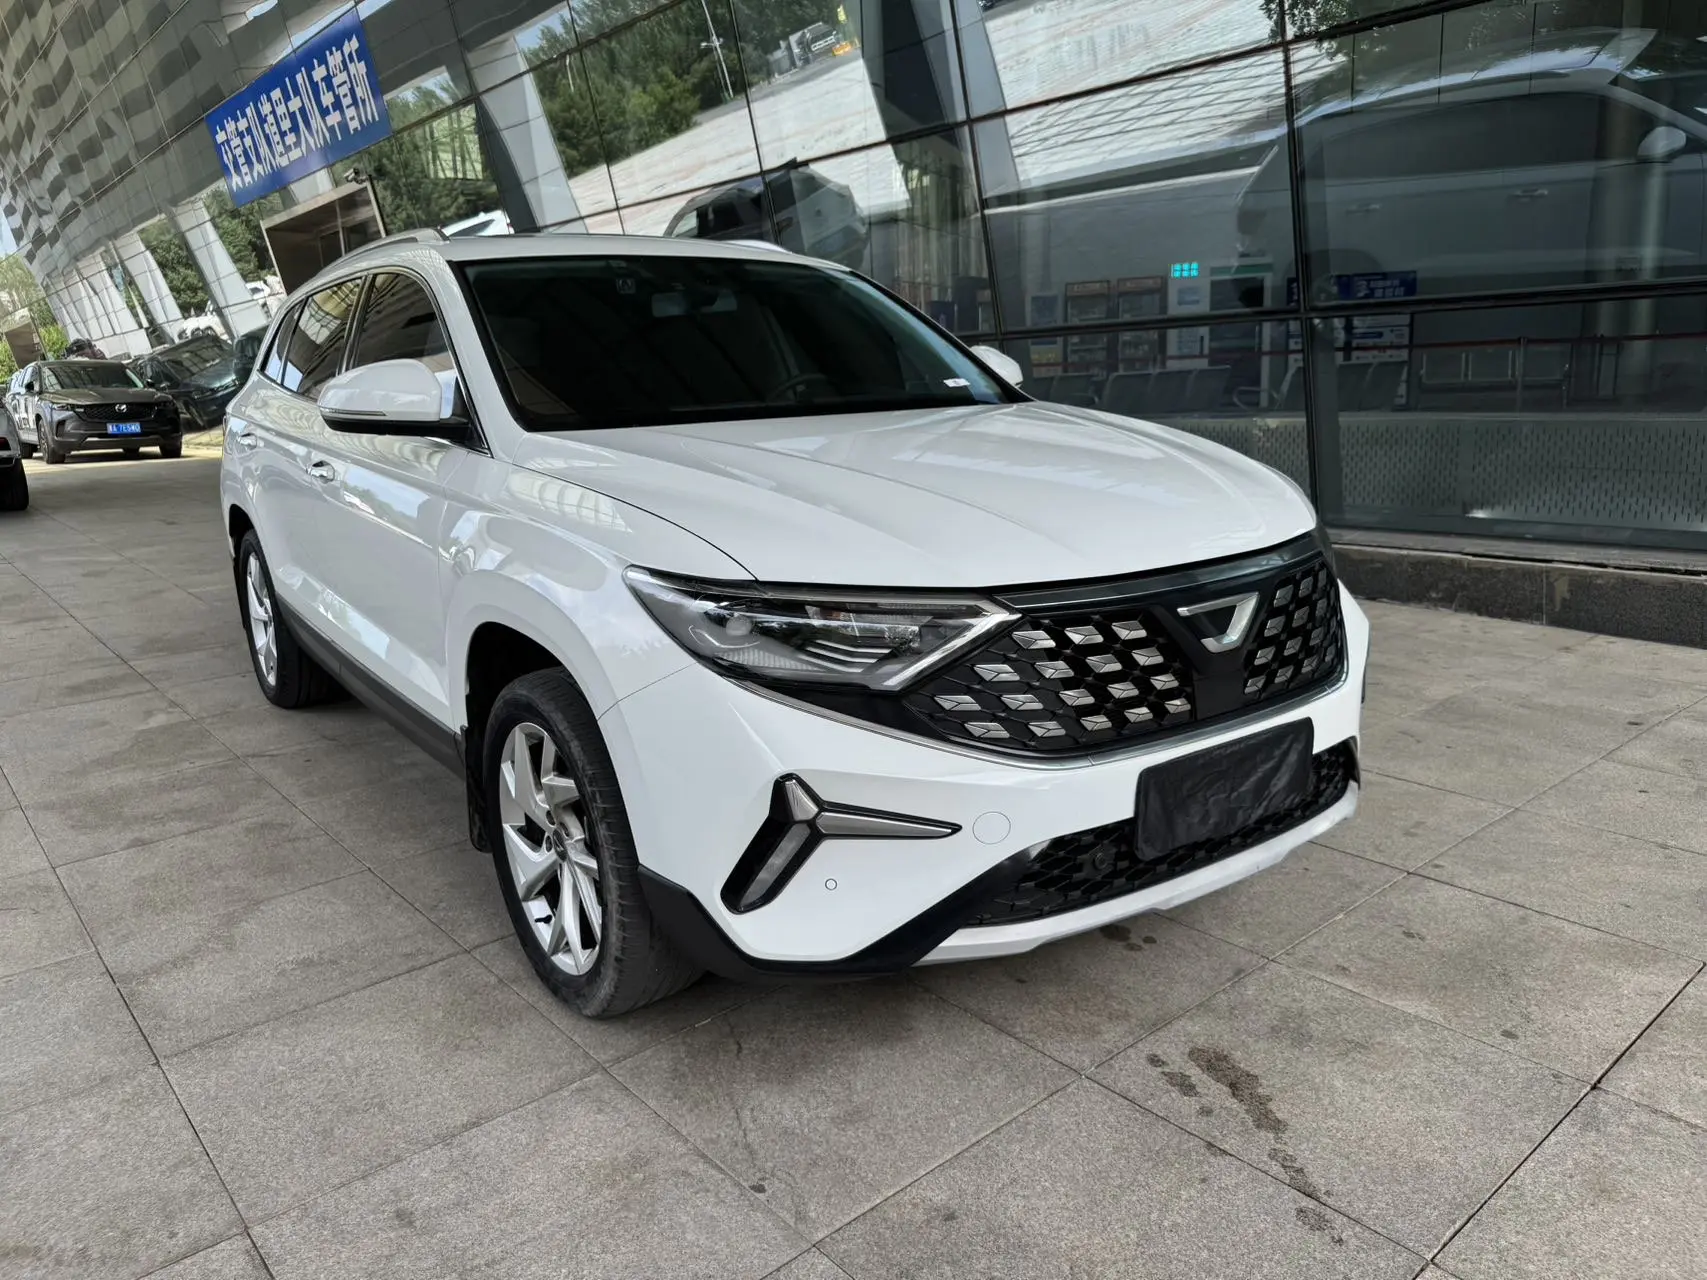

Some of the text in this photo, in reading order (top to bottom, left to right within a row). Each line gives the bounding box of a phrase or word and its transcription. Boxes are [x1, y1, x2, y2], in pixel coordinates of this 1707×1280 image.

[215, 33, 379, 192] 交管支队道里大队车管所
